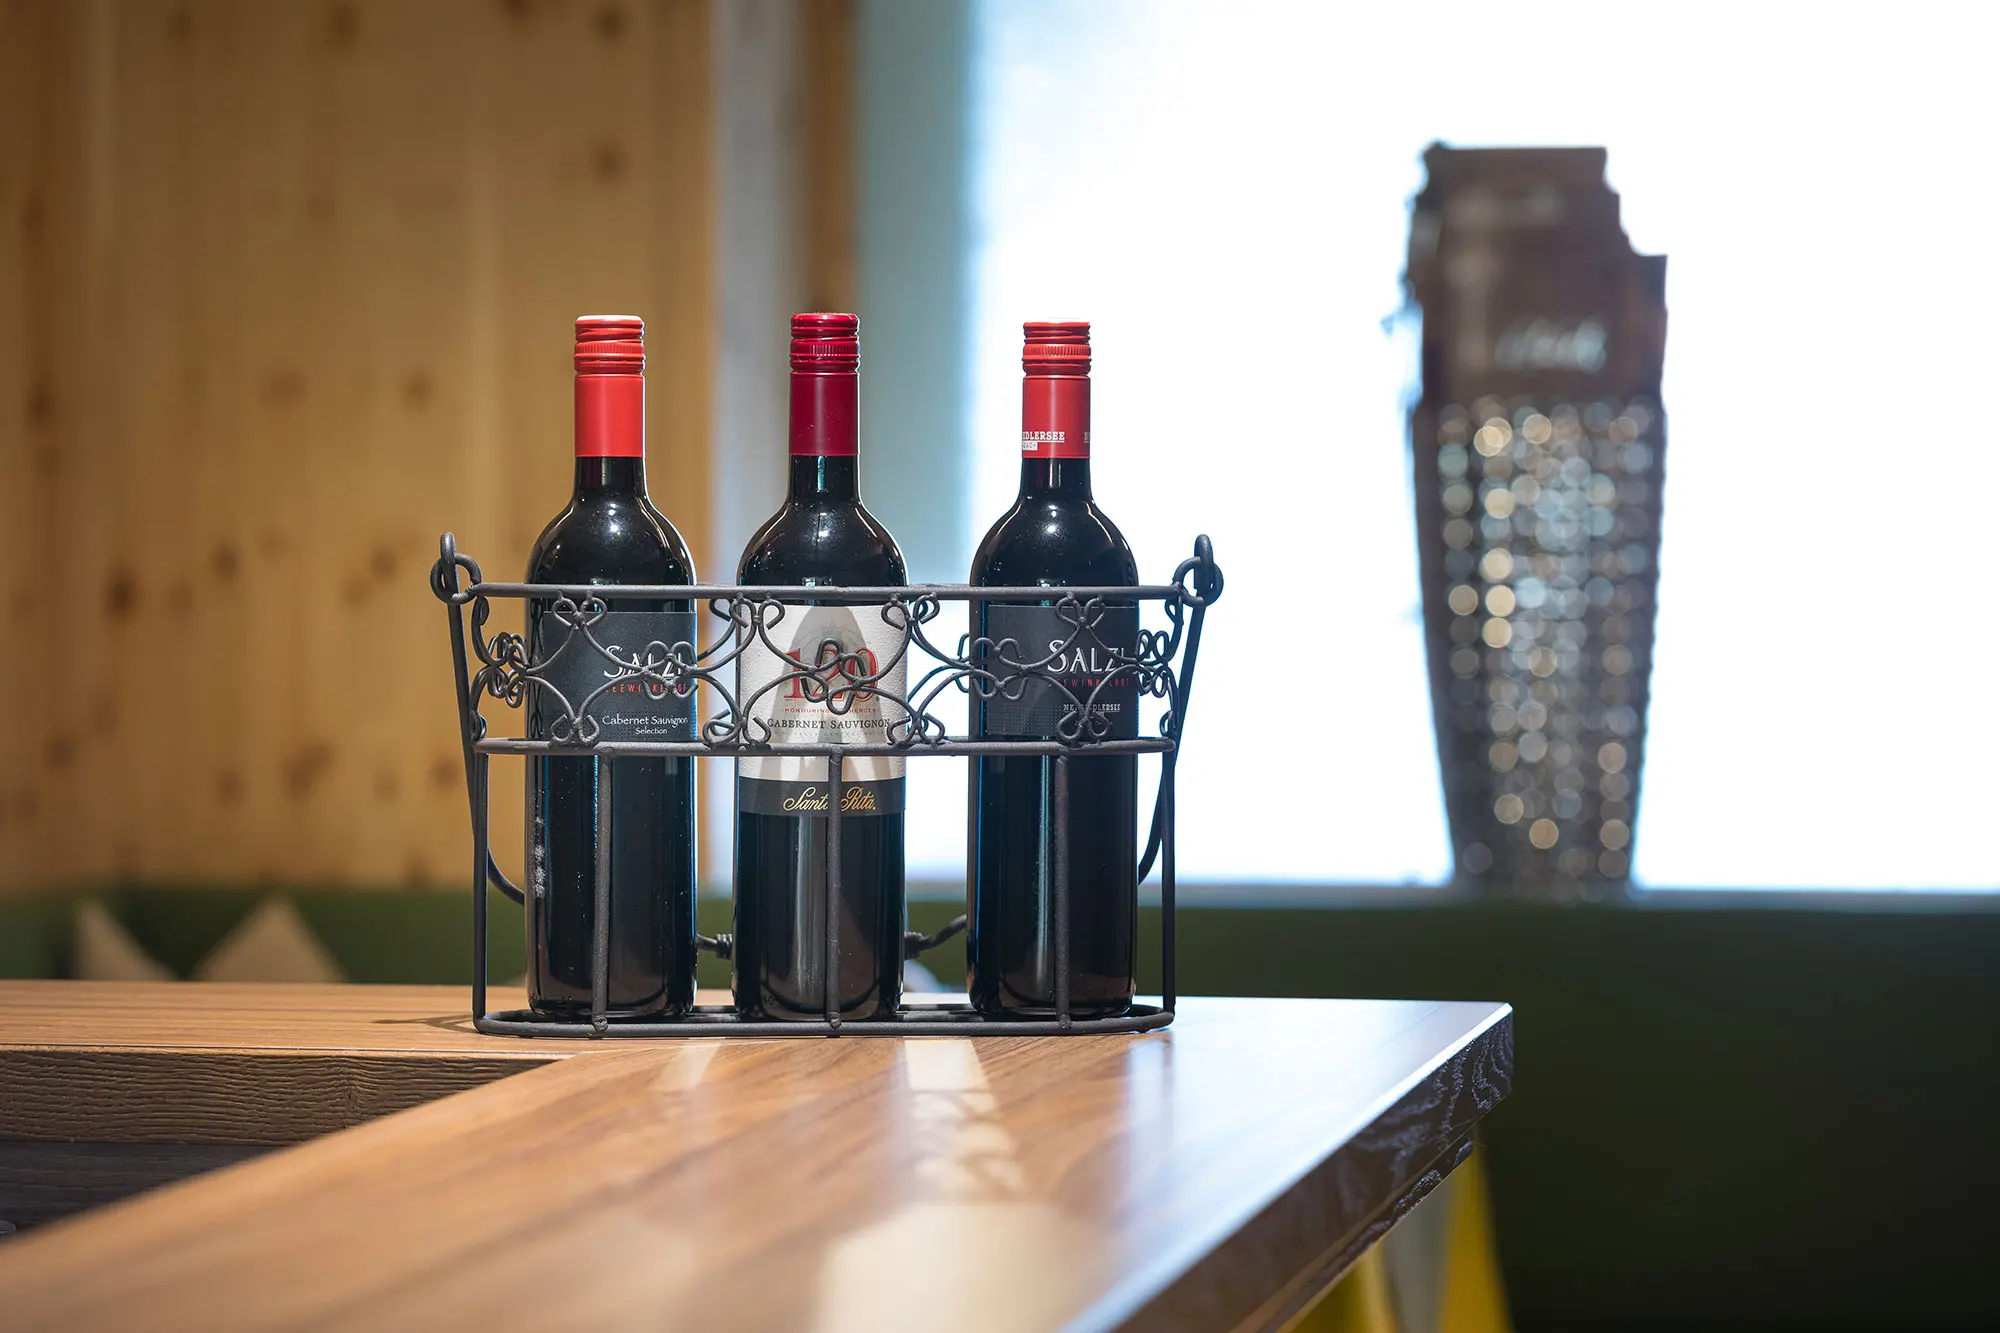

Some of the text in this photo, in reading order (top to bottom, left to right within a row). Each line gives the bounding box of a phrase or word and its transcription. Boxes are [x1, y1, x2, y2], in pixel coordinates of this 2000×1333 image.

[783, 648, 879, 702] 120
[602, 713, 688, 728] Cabernet Sauvignon
[767, 718, 890, 730] CABERNET SAUVIGNON
[635, 726, 667, 735] Selection
